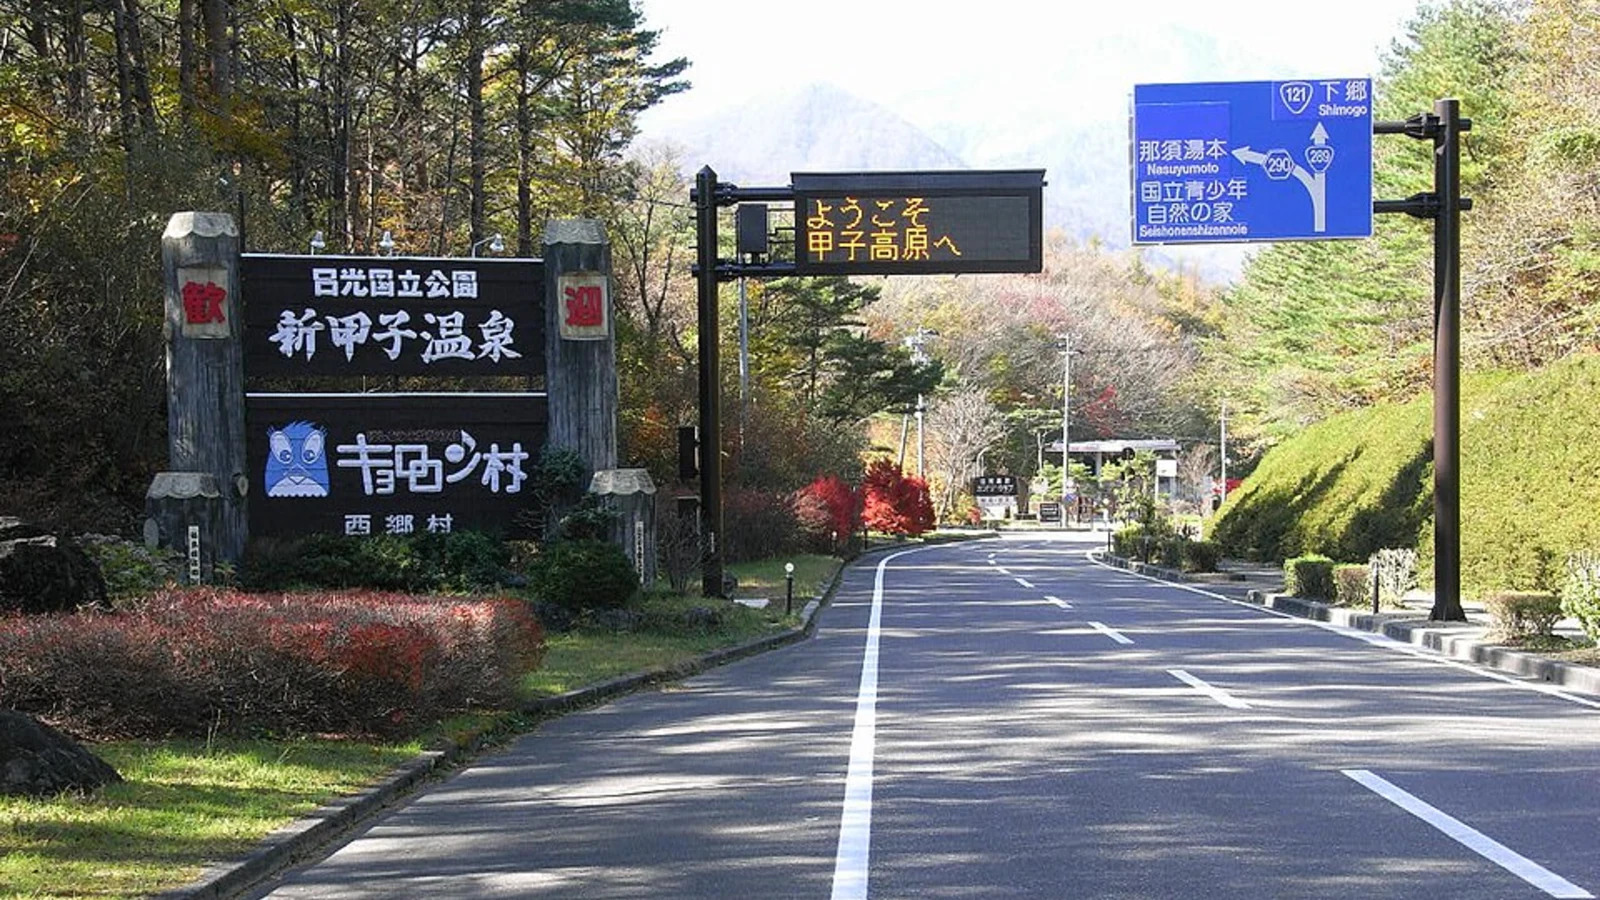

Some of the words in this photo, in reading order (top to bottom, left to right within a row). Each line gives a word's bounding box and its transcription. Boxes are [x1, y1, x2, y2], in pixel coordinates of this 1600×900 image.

[1286, 87, 1306, 102] 121
[1320, 81, 1367, 102] 下郷
[1319, 104, 1367, 117] Shimogo
[1139, 139, 1227, 162] 那須湯本
[1310, 150, 1330, 163] 289
[1147, 163, 1219, 177] Nasuyumoto
[1268, 157, 1291, 172] 290
[1141, 179, 1248, 201] 国立青少年
[807, 197, 929, 229] ようこそ
[1147, 202, 1234, 224] 自然の家
[808, 228, 961, 261] 甲子高原へ
[313, 268, 477, 298] 日光国立公園
[182, 281, 227, 324] 歓
[565, 286, 602, 327] 迎
[269, 308, 522, 364] 新甲子温泉
[337, 430, 529, 495] キョロロン村
[345, 514, 453, 535] 西郷村
